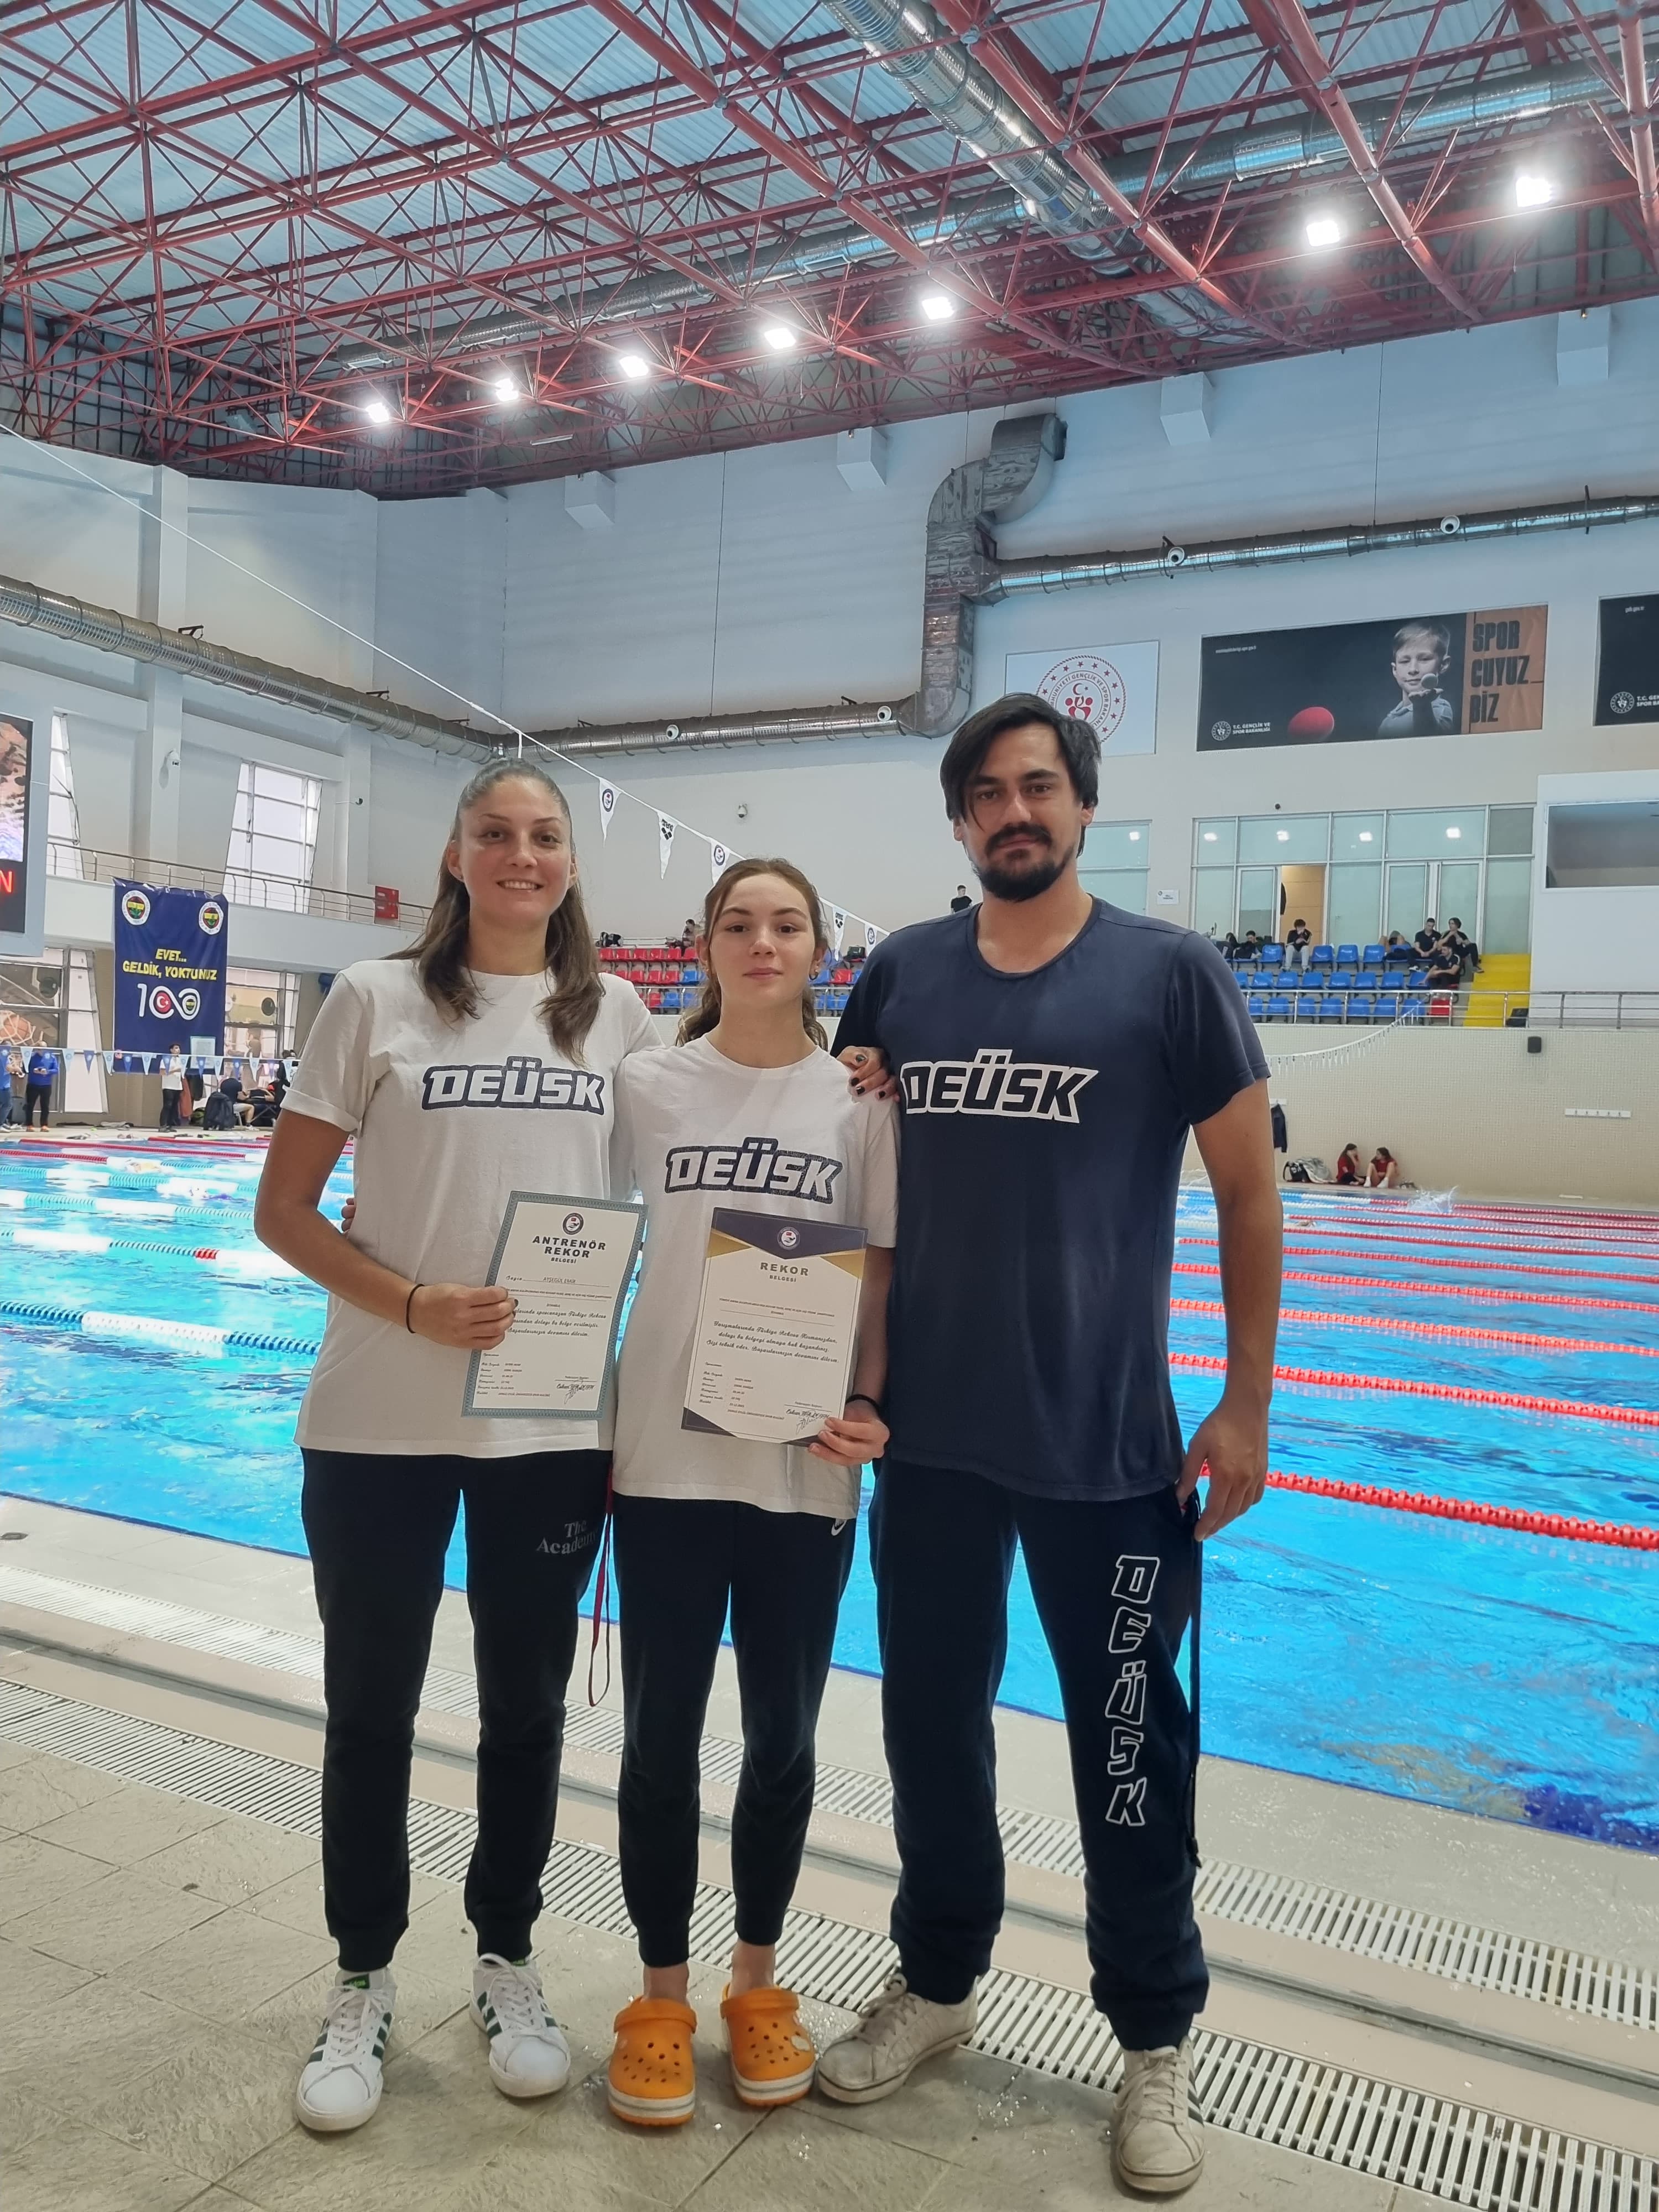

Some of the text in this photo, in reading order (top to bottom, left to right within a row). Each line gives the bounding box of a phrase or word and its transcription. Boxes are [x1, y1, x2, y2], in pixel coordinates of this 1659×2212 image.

[1472, 620, 1520, 653] SPOR
[1470, 655, 1530, 687] CUYUZ
[1093, 704, 1109, 727] BAKANL
[1469, 691, 1500, 723] BİZ
[155, 948, 187, 962] EVET...
[123, 961, 217, 980] GELDİK, YOKTUNUZ
[421, 1056, 605, 1115] DEÜSK
[900, 1048, 1099, 1123] DEÜSK
[664, 1136, 843, 1205] DEÜSK
[532, 1235, 606, 1250] ANTRENÖR
[544, 1246, 590, 1258] REKOR
[760, 1262, 808, 1276] REKOR
[565, 1520, 587, 1538] The
[536, 1530, 598, 1554] Academ
[1105, 1554, 1160, 1826] DEÜSK
